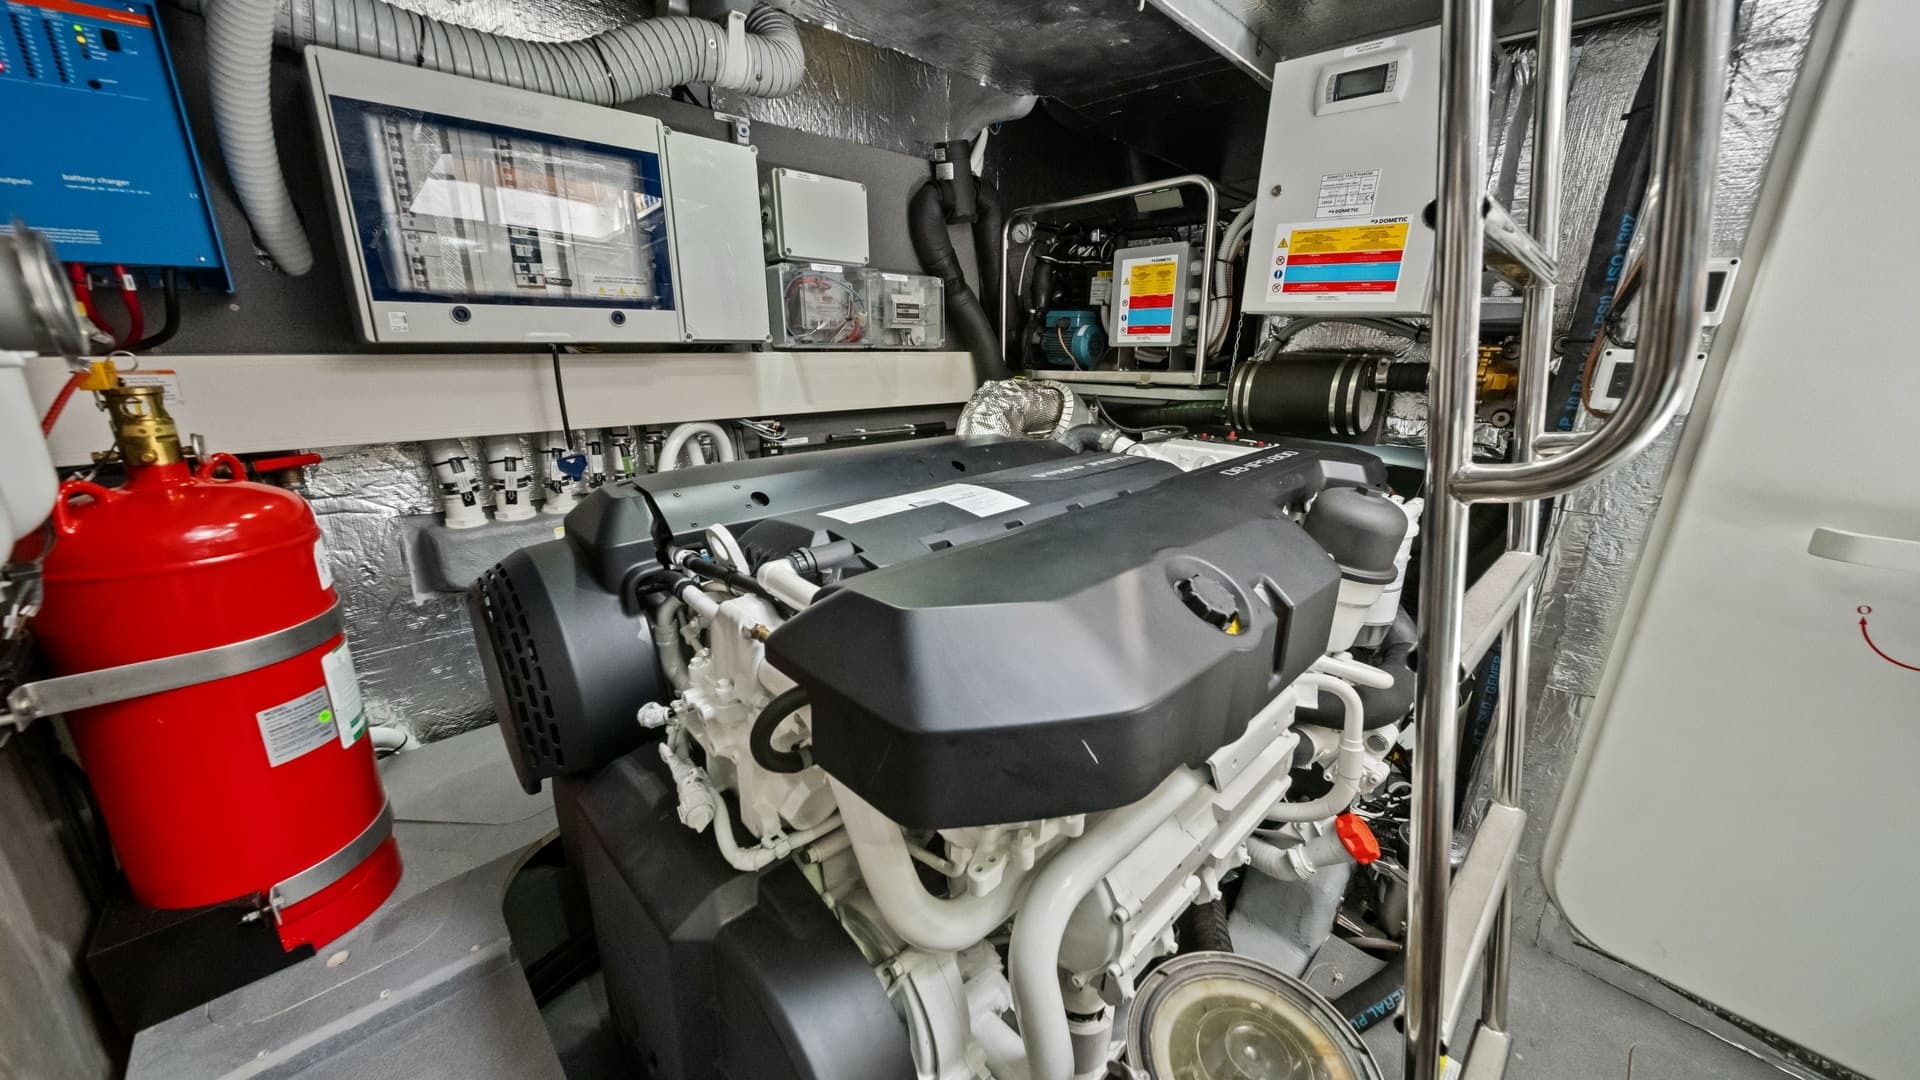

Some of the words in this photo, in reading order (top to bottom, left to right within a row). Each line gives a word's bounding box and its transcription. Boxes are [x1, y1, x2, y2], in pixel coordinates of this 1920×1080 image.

[1379, 216, 1408, 224] DOMETIC
[1615, 213, 1634, 249] 1307
[1606, 254, 1625, 283] ISO
[1367, 988, 1405, 1018] ERAL
